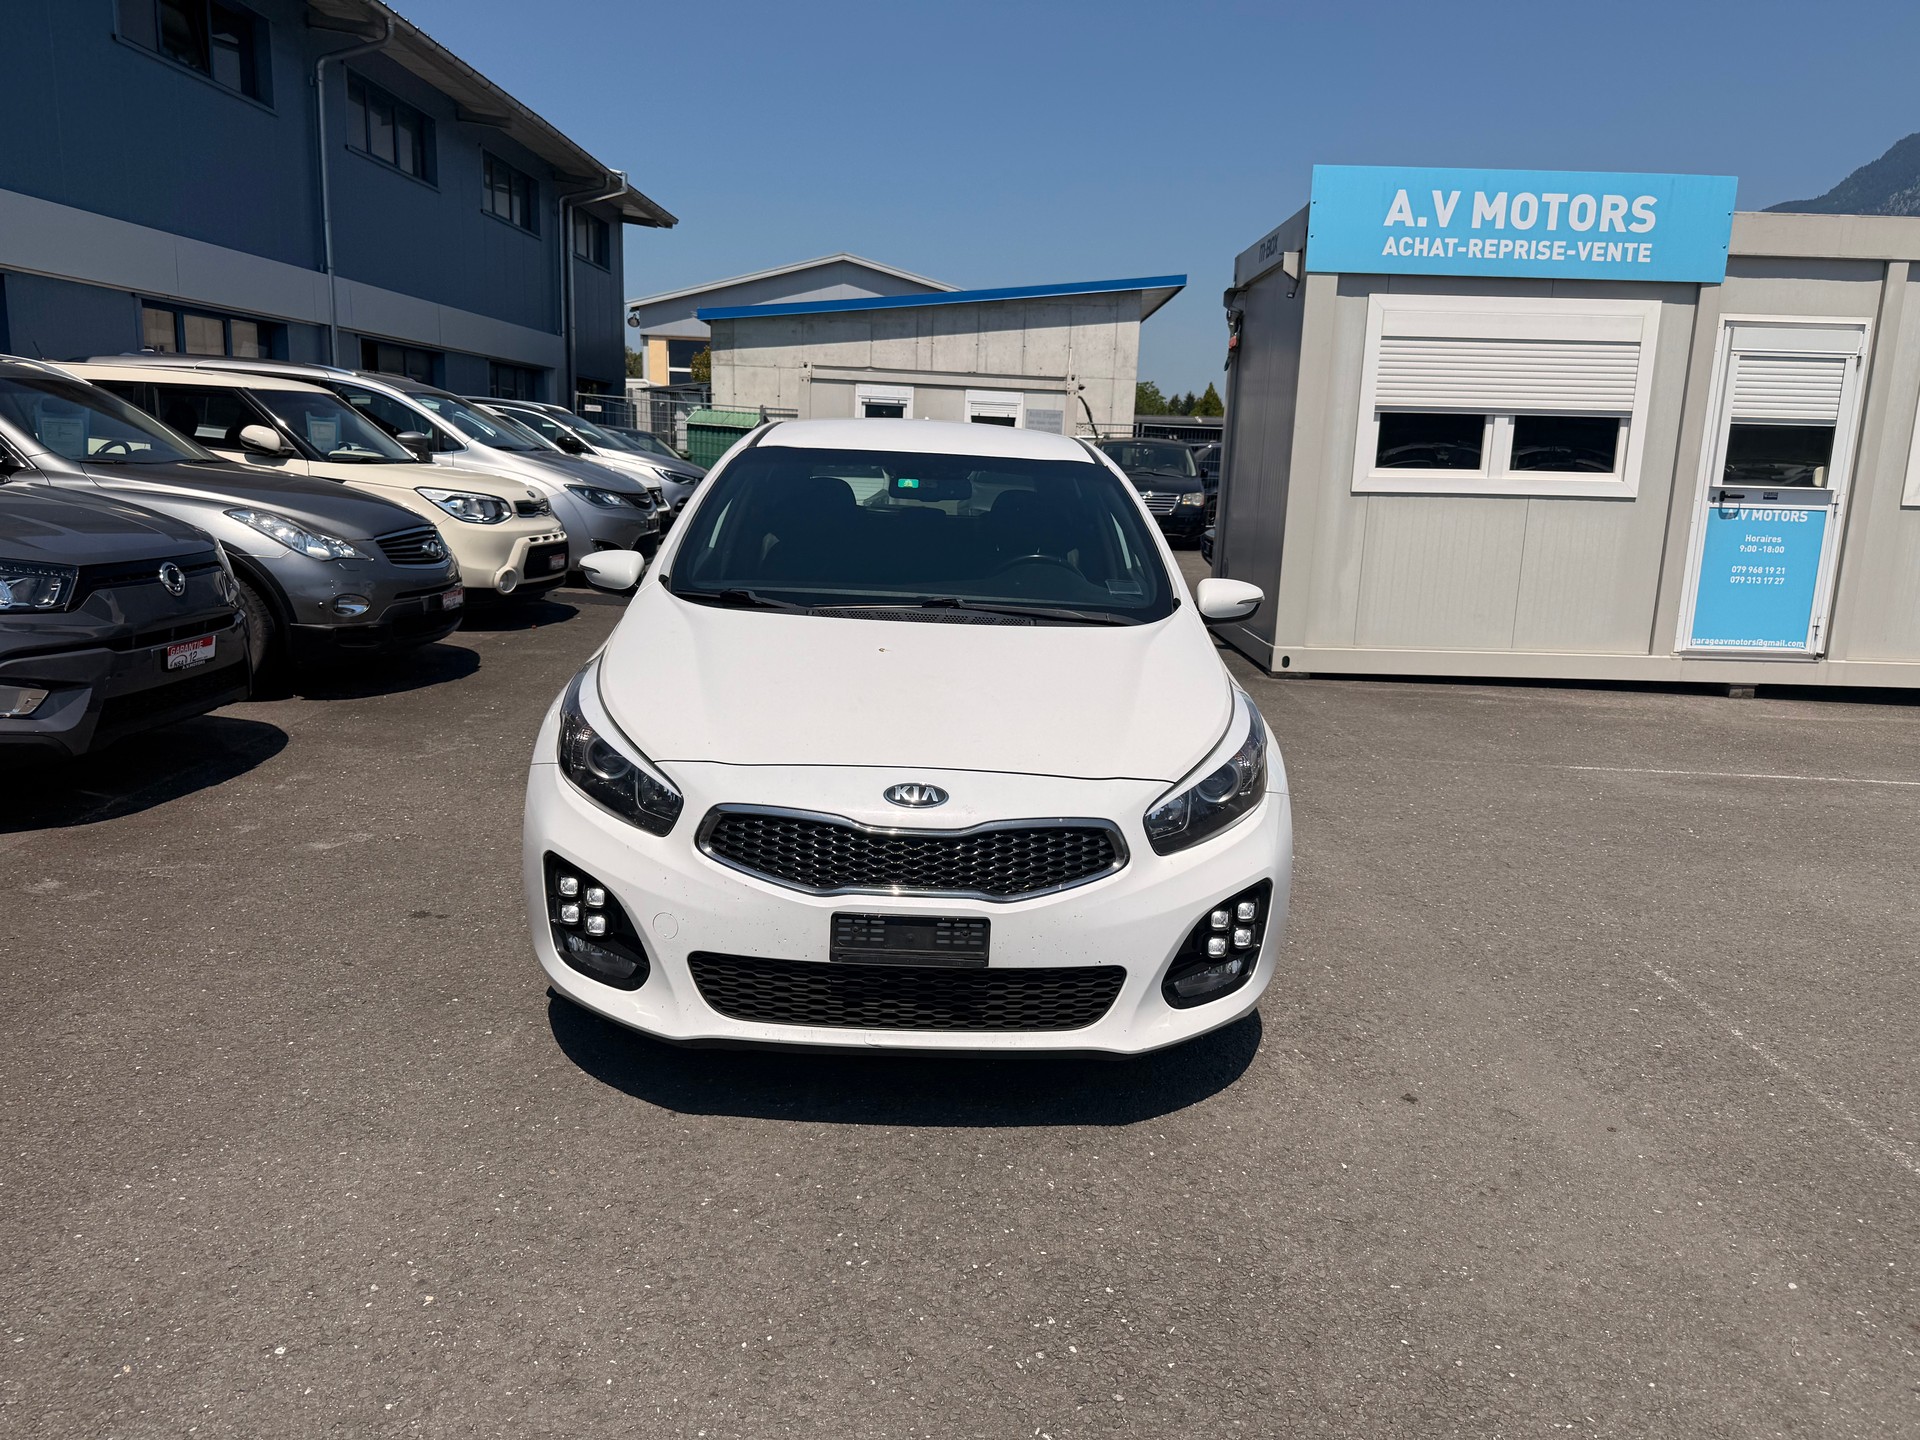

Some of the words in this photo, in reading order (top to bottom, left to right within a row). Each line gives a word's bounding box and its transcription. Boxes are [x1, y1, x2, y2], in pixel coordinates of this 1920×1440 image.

[1383, 188, 1462, 228] A.V
[1471, 191, 1658, 233] MOTORS
[1381, 236, 1653, 263] ACHAT-REPRISE-VENTE
[1751, 509, 1808, 522] MOTORS
[1745, 534, 1782, 543] Horaires
[1739, 544, 1757, 553] 9:00
[1731, 565, 1746, 574] 079
[1748, 566, 1763, 574] 968
[1765, 566, 1775, 574] 19
[1776, 567, 1786, 575] 21
[1730, 575, 1745, 584] 079
[1746, 576, 1761, 584] 313
[1763, 576, 1774, 585] 17
[1774, 577, 1785, 585] 27
[170, 640, 204, 656] GARANTIE
[1691, 637, 1805, 649] garageavmotors@gmail.com
[188, 650, 198, 662] 12
[894, 785, 939, 802] KIA
